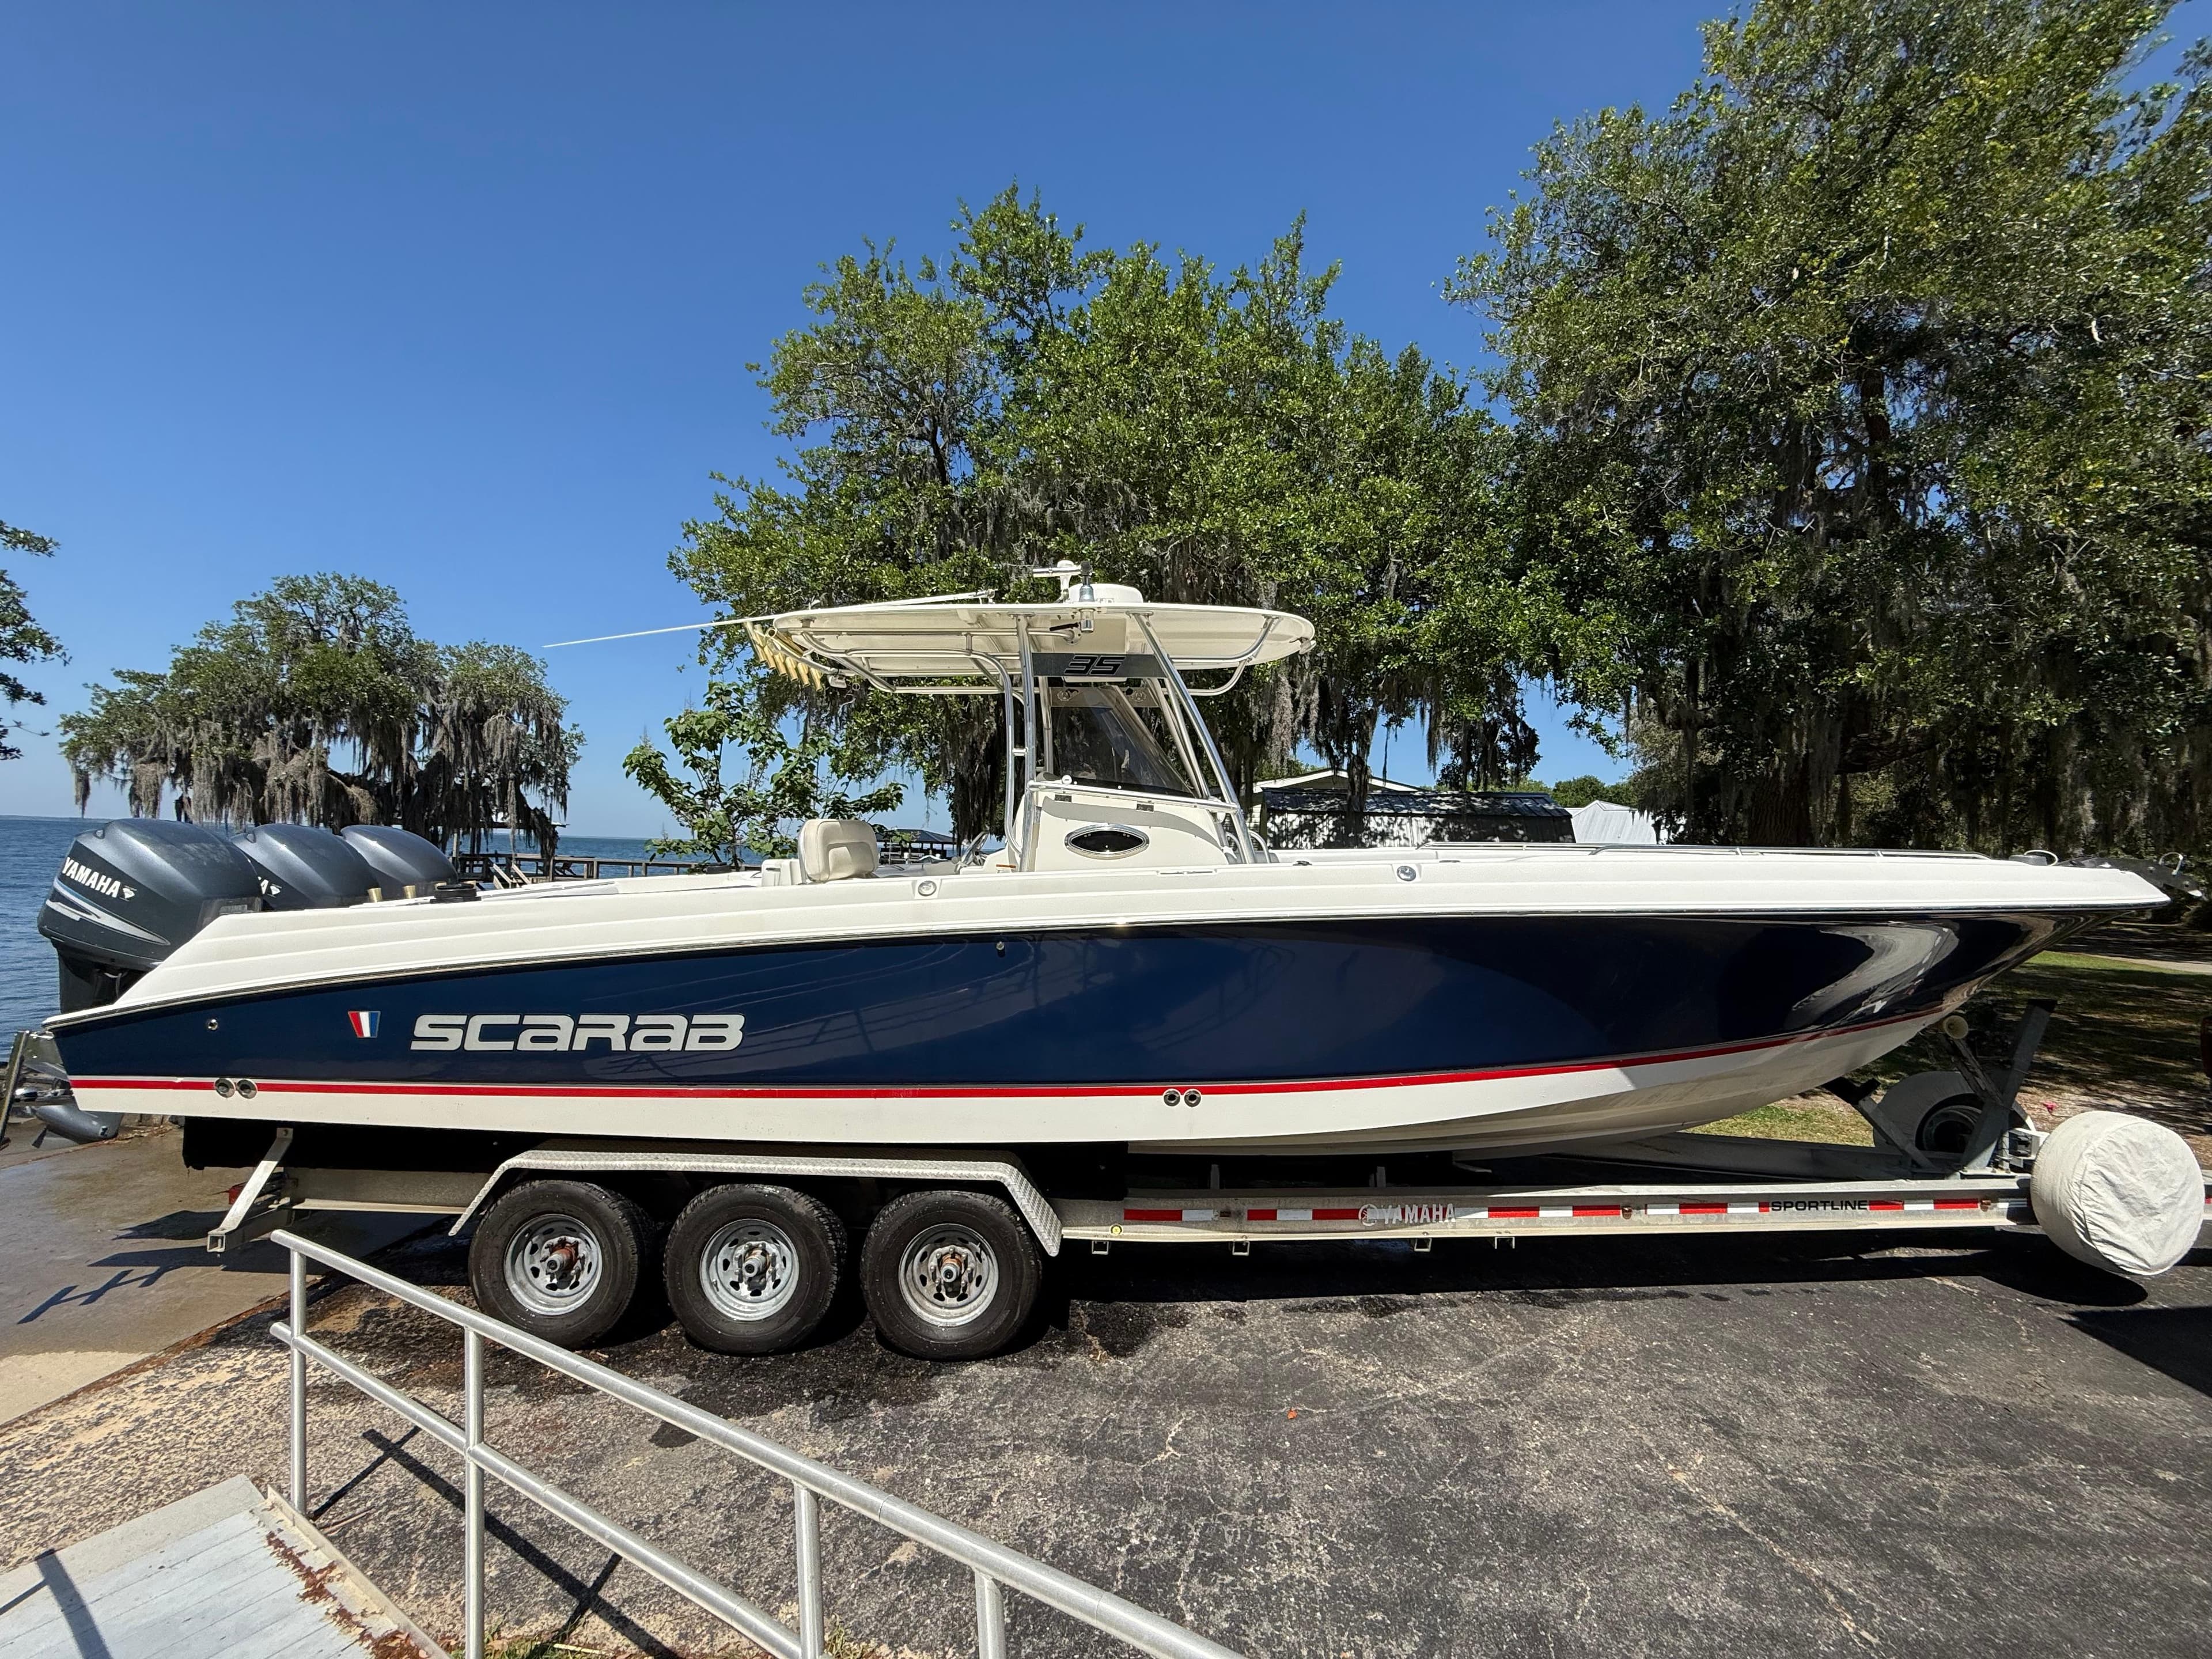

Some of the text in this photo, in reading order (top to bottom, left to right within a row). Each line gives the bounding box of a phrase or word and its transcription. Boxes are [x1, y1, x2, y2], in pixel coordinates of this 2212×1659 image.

[1064, 654, 1126, 675] 35
[62, 857, 121, 898] YAMAHA
[1381, 1203, 1456, 1224] YAMAHA
[1771, 1200, 1868, 1211] SPORTLINE
